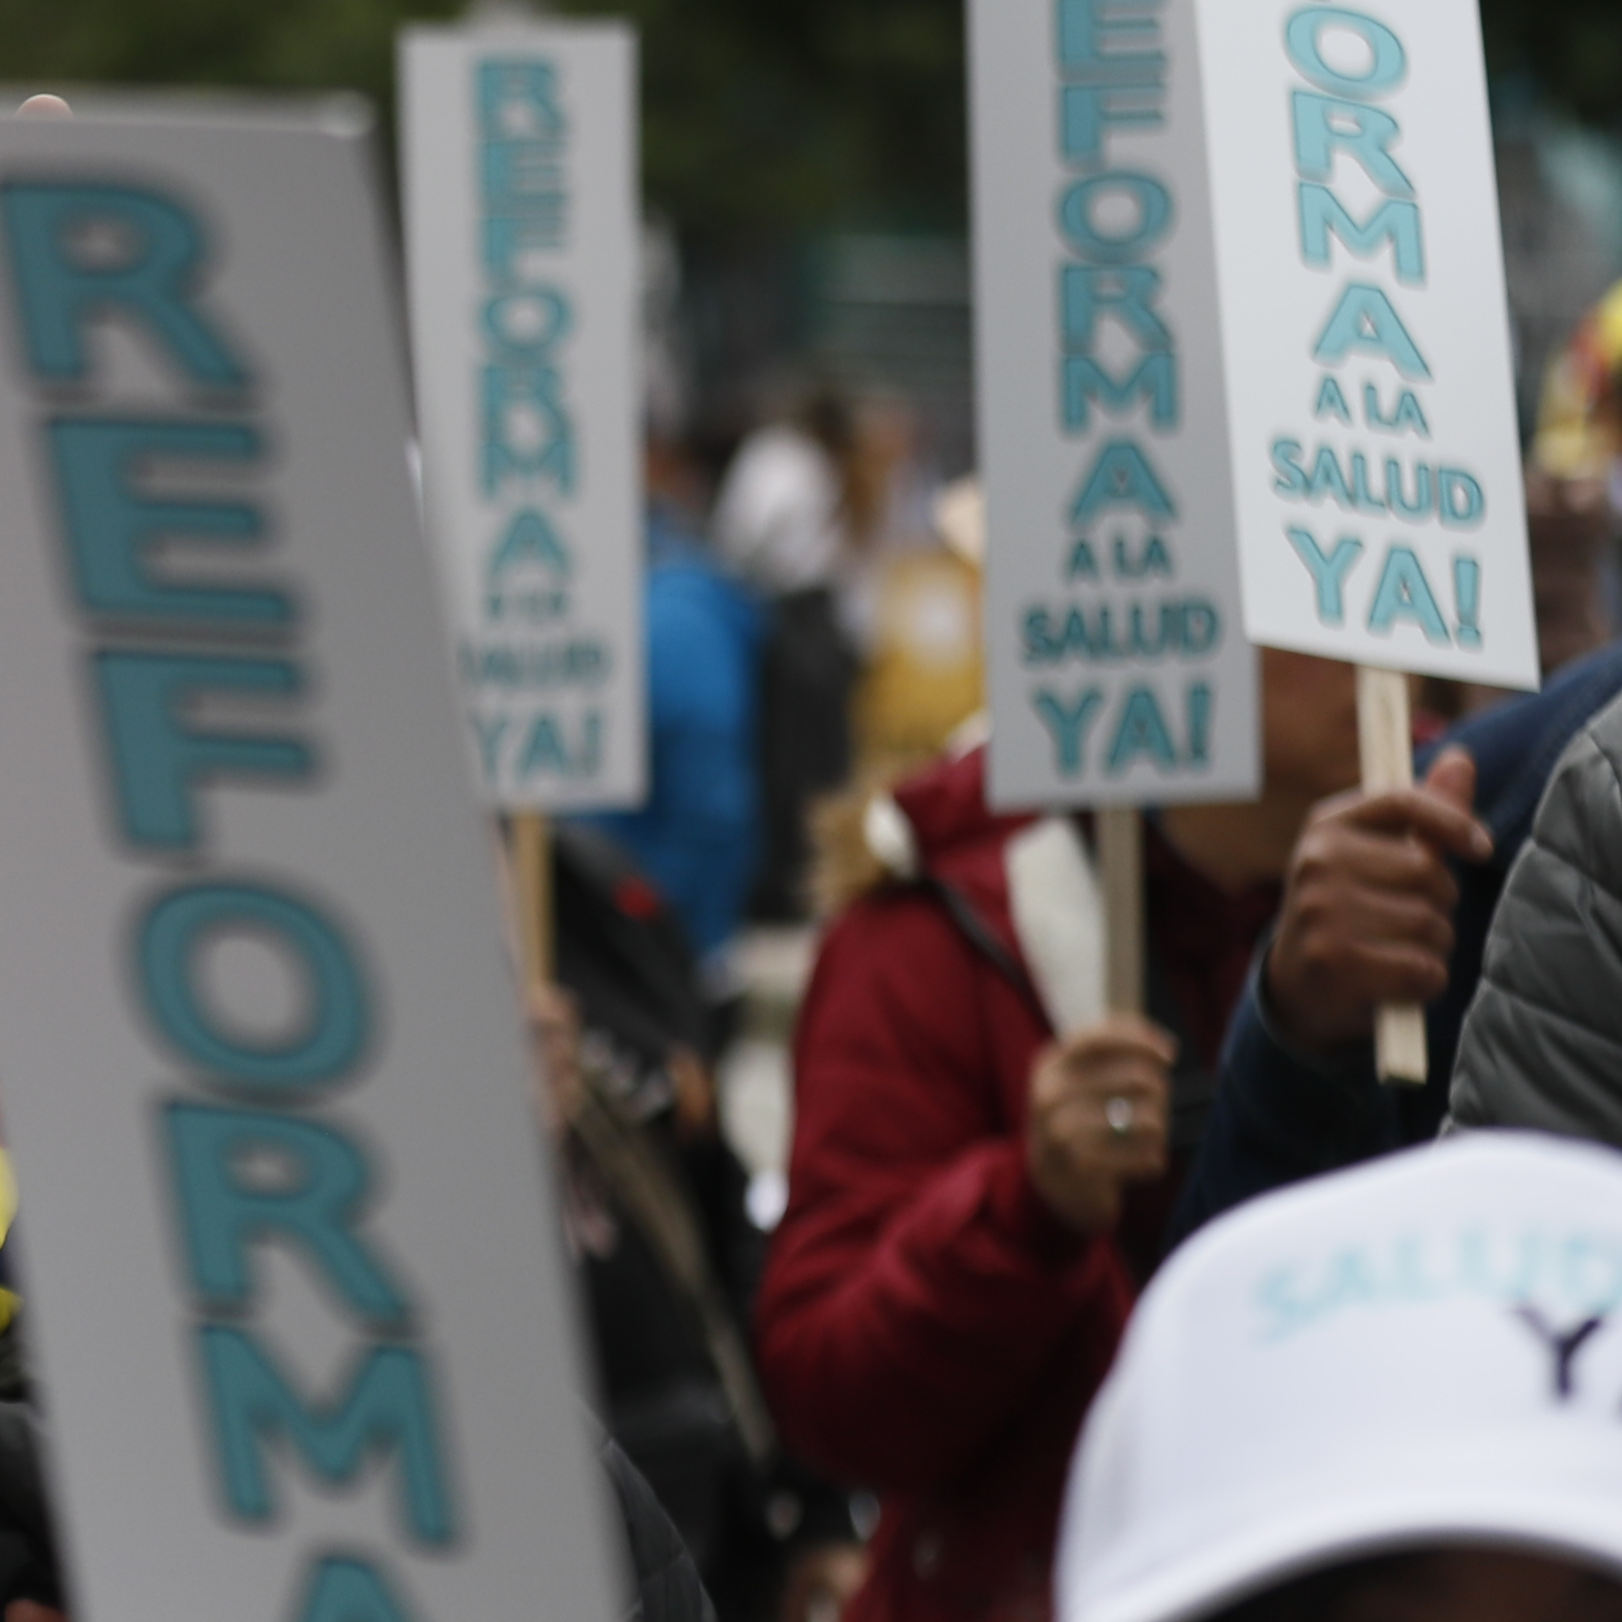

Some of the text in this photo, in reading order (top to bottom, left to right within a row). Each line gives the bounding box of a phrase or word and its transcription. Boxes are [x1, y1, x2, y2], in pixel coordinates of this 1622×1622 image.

[1316, 376, 1429, 438] A LA
[1270, 438, 1485, 525] SALUD
[1284, 525, 1484, 650] YA!
[1016, 598, 1222, 670] SALUD
[1030, 680, 1213, 780] YA!
